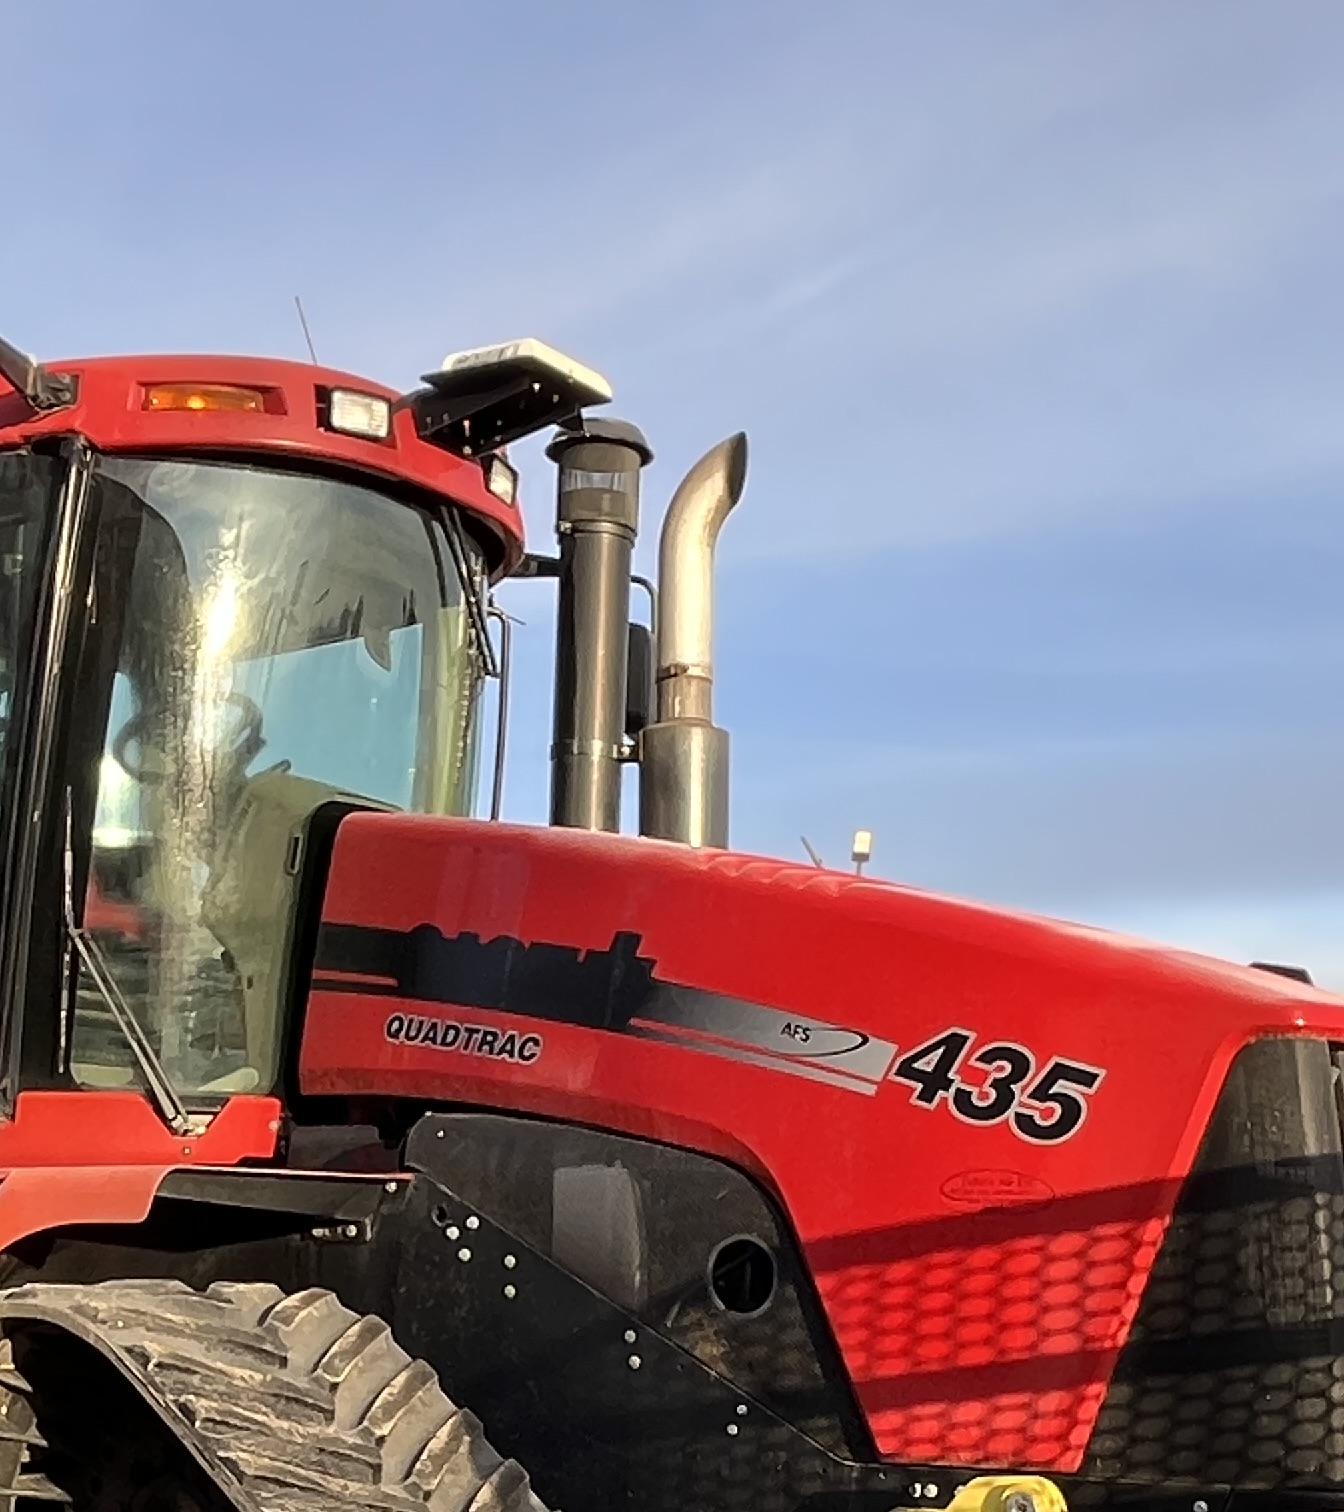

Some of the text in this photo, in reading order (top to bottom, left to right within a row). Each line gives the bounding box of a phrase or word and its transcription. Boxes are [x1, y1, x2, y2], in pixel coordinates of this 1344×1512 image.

[386, 1014, 541, 1063] QUADTRAC
[780, 1022, 811, 1043] AFS
[891, 1028, 1105, 1144] 435
